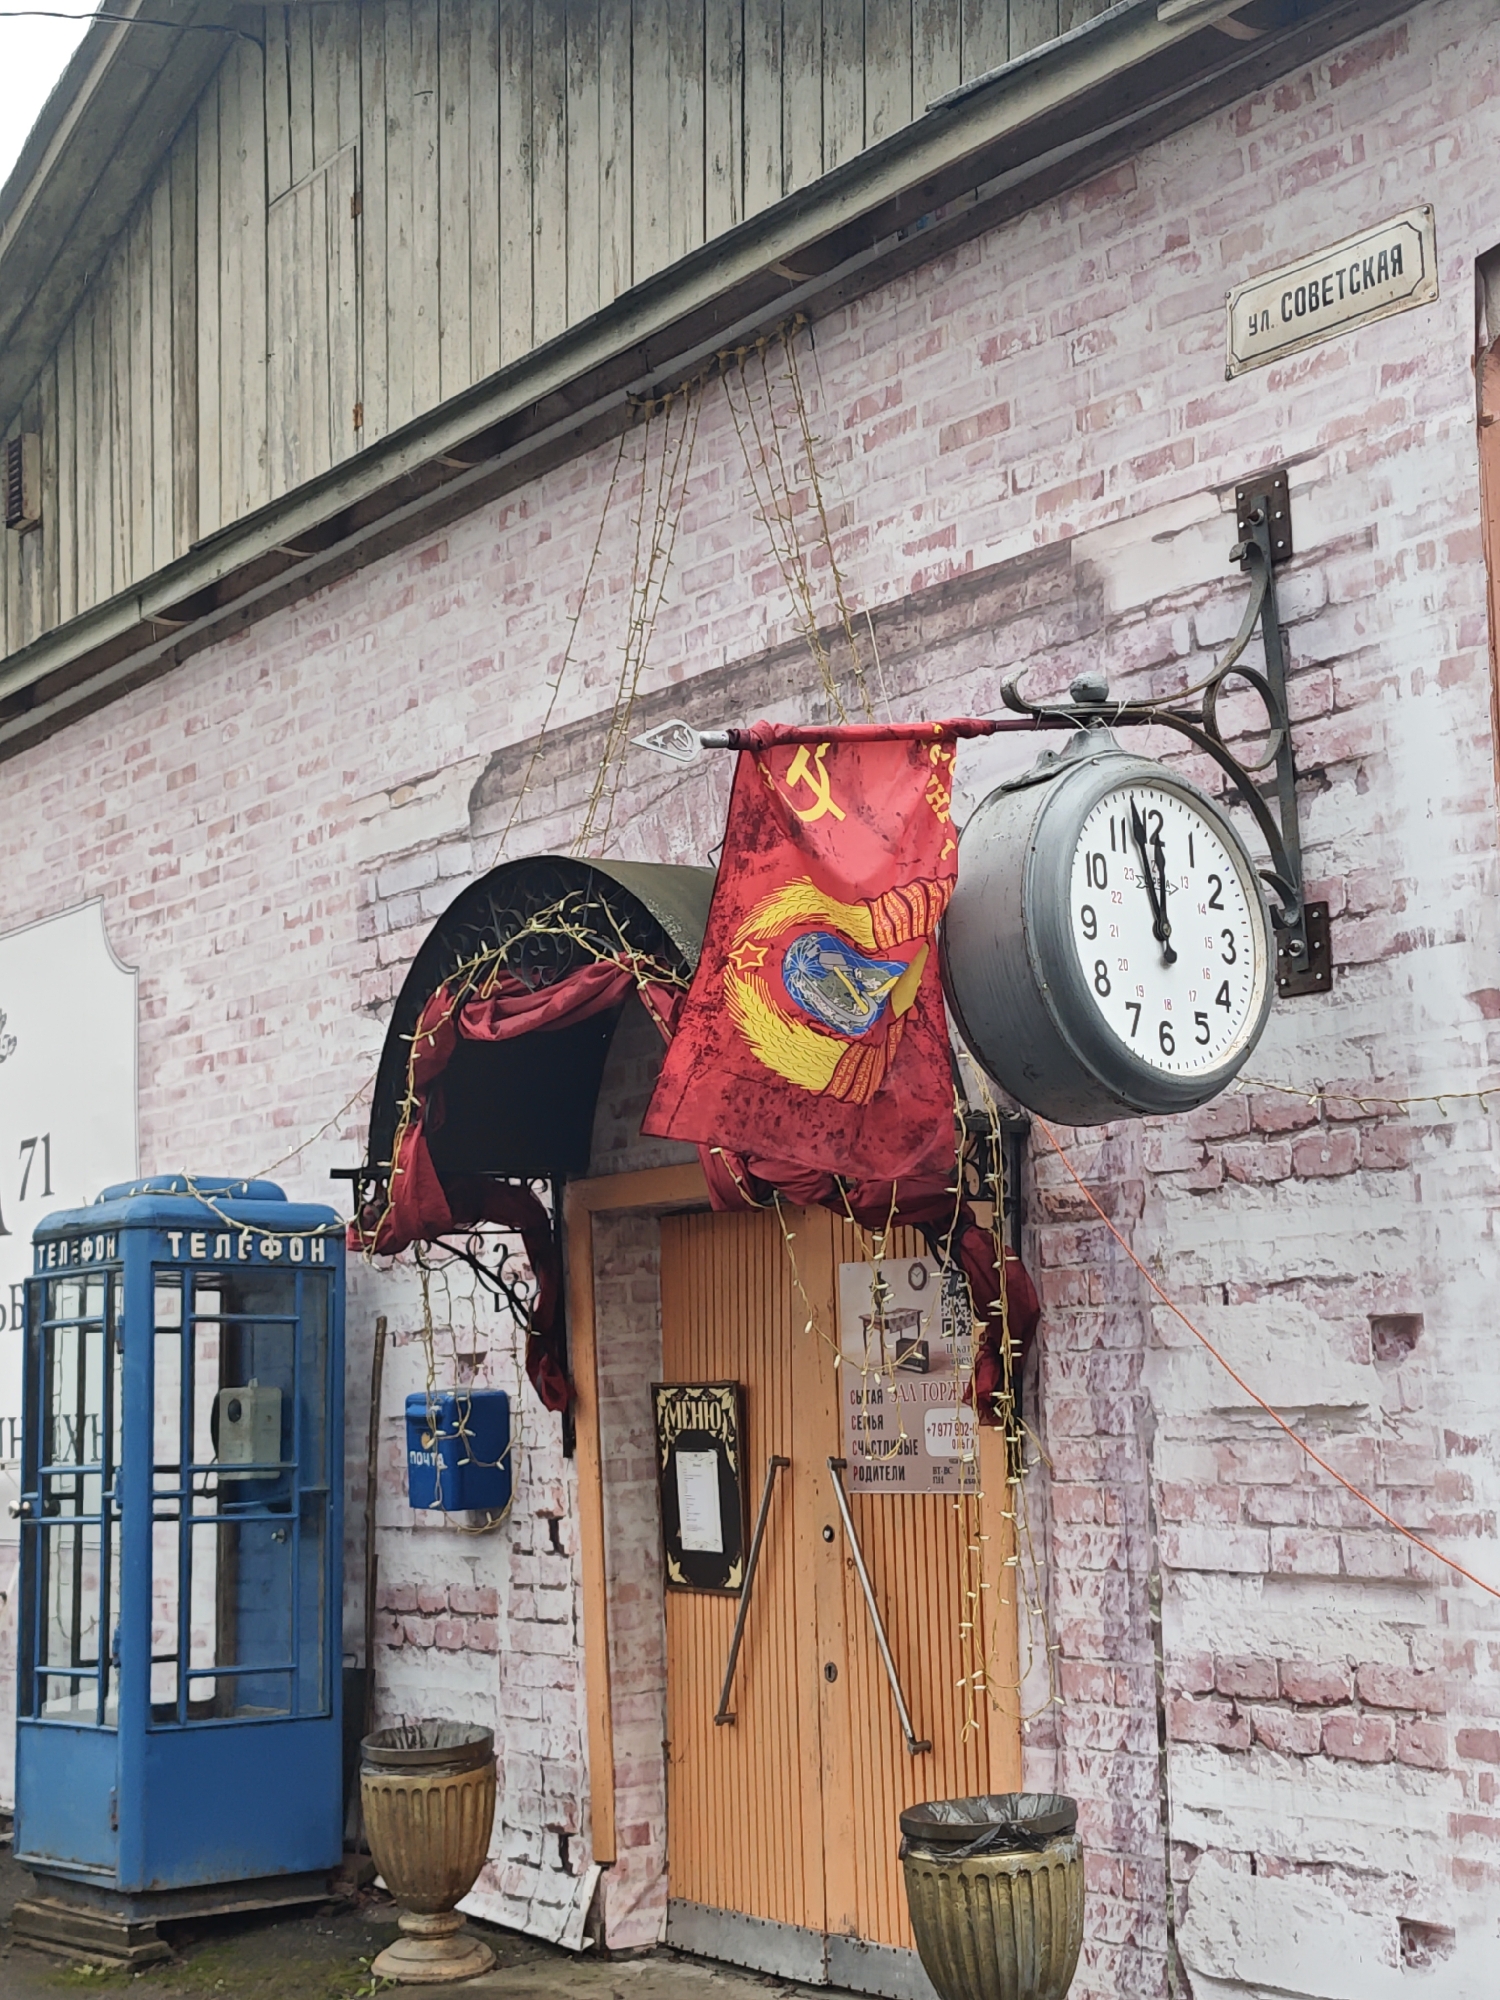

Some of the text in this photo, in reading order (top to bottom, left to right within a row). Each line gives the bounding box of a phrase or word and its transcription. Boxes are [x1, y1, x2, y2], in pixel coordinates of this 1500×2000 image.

[1280, 243, 1404, 323] СОВЕТСКАЯ
[1110, 814, 1127, 854] 11
[1142, 807, 1165, 847] 12
[1188, 831, 1195, 868] 1
[1085, 850, 1107, 890] 10
[1123, 867, 1135, 881] 23
[1181, 875, 1189, 889] 13
[1111, 891, 1123, 905] 22
[1208, 874, 1224, 910] 2
[1080, 904, 1098, 940] 9
[1197, 903, 1207, 915] 14
[1109, 924, 1119, 938] 21
[1204, 936, 1213, 949] 15
[1221, 928, 1237, 965] 3
[1094, 959, 1111, 997] 8
[1117, 958, 1128, 972] 20
[1202, 967, 1211, 980] 16
[1135, 985, 1144, 998] 19
[1164, 998, 1172, 1011] 18
[1188, 989, 1197, 1002] 17
[1215, 979, 1231, 1013] 4
[1125, 1001, 1142, 1038] 7
[1194, 1011, 1210, 1045] 5
[1158, 1020, 1175, 1056] 6
[18, 1132, 55, 1202] 71
[167, 1231, 325, 1263] ТЕЛЕФОН
[920, 1382, 969, 1401] ТОРЖ
[667, 1401, 722, 1430] МЕНЮ
[952, 1438, 974, 1450] ОЬГА
[409, 1451, 445, 1467] ПОЧТА
[853, 1465, 905, 1482] РОДИТЕЛИ
